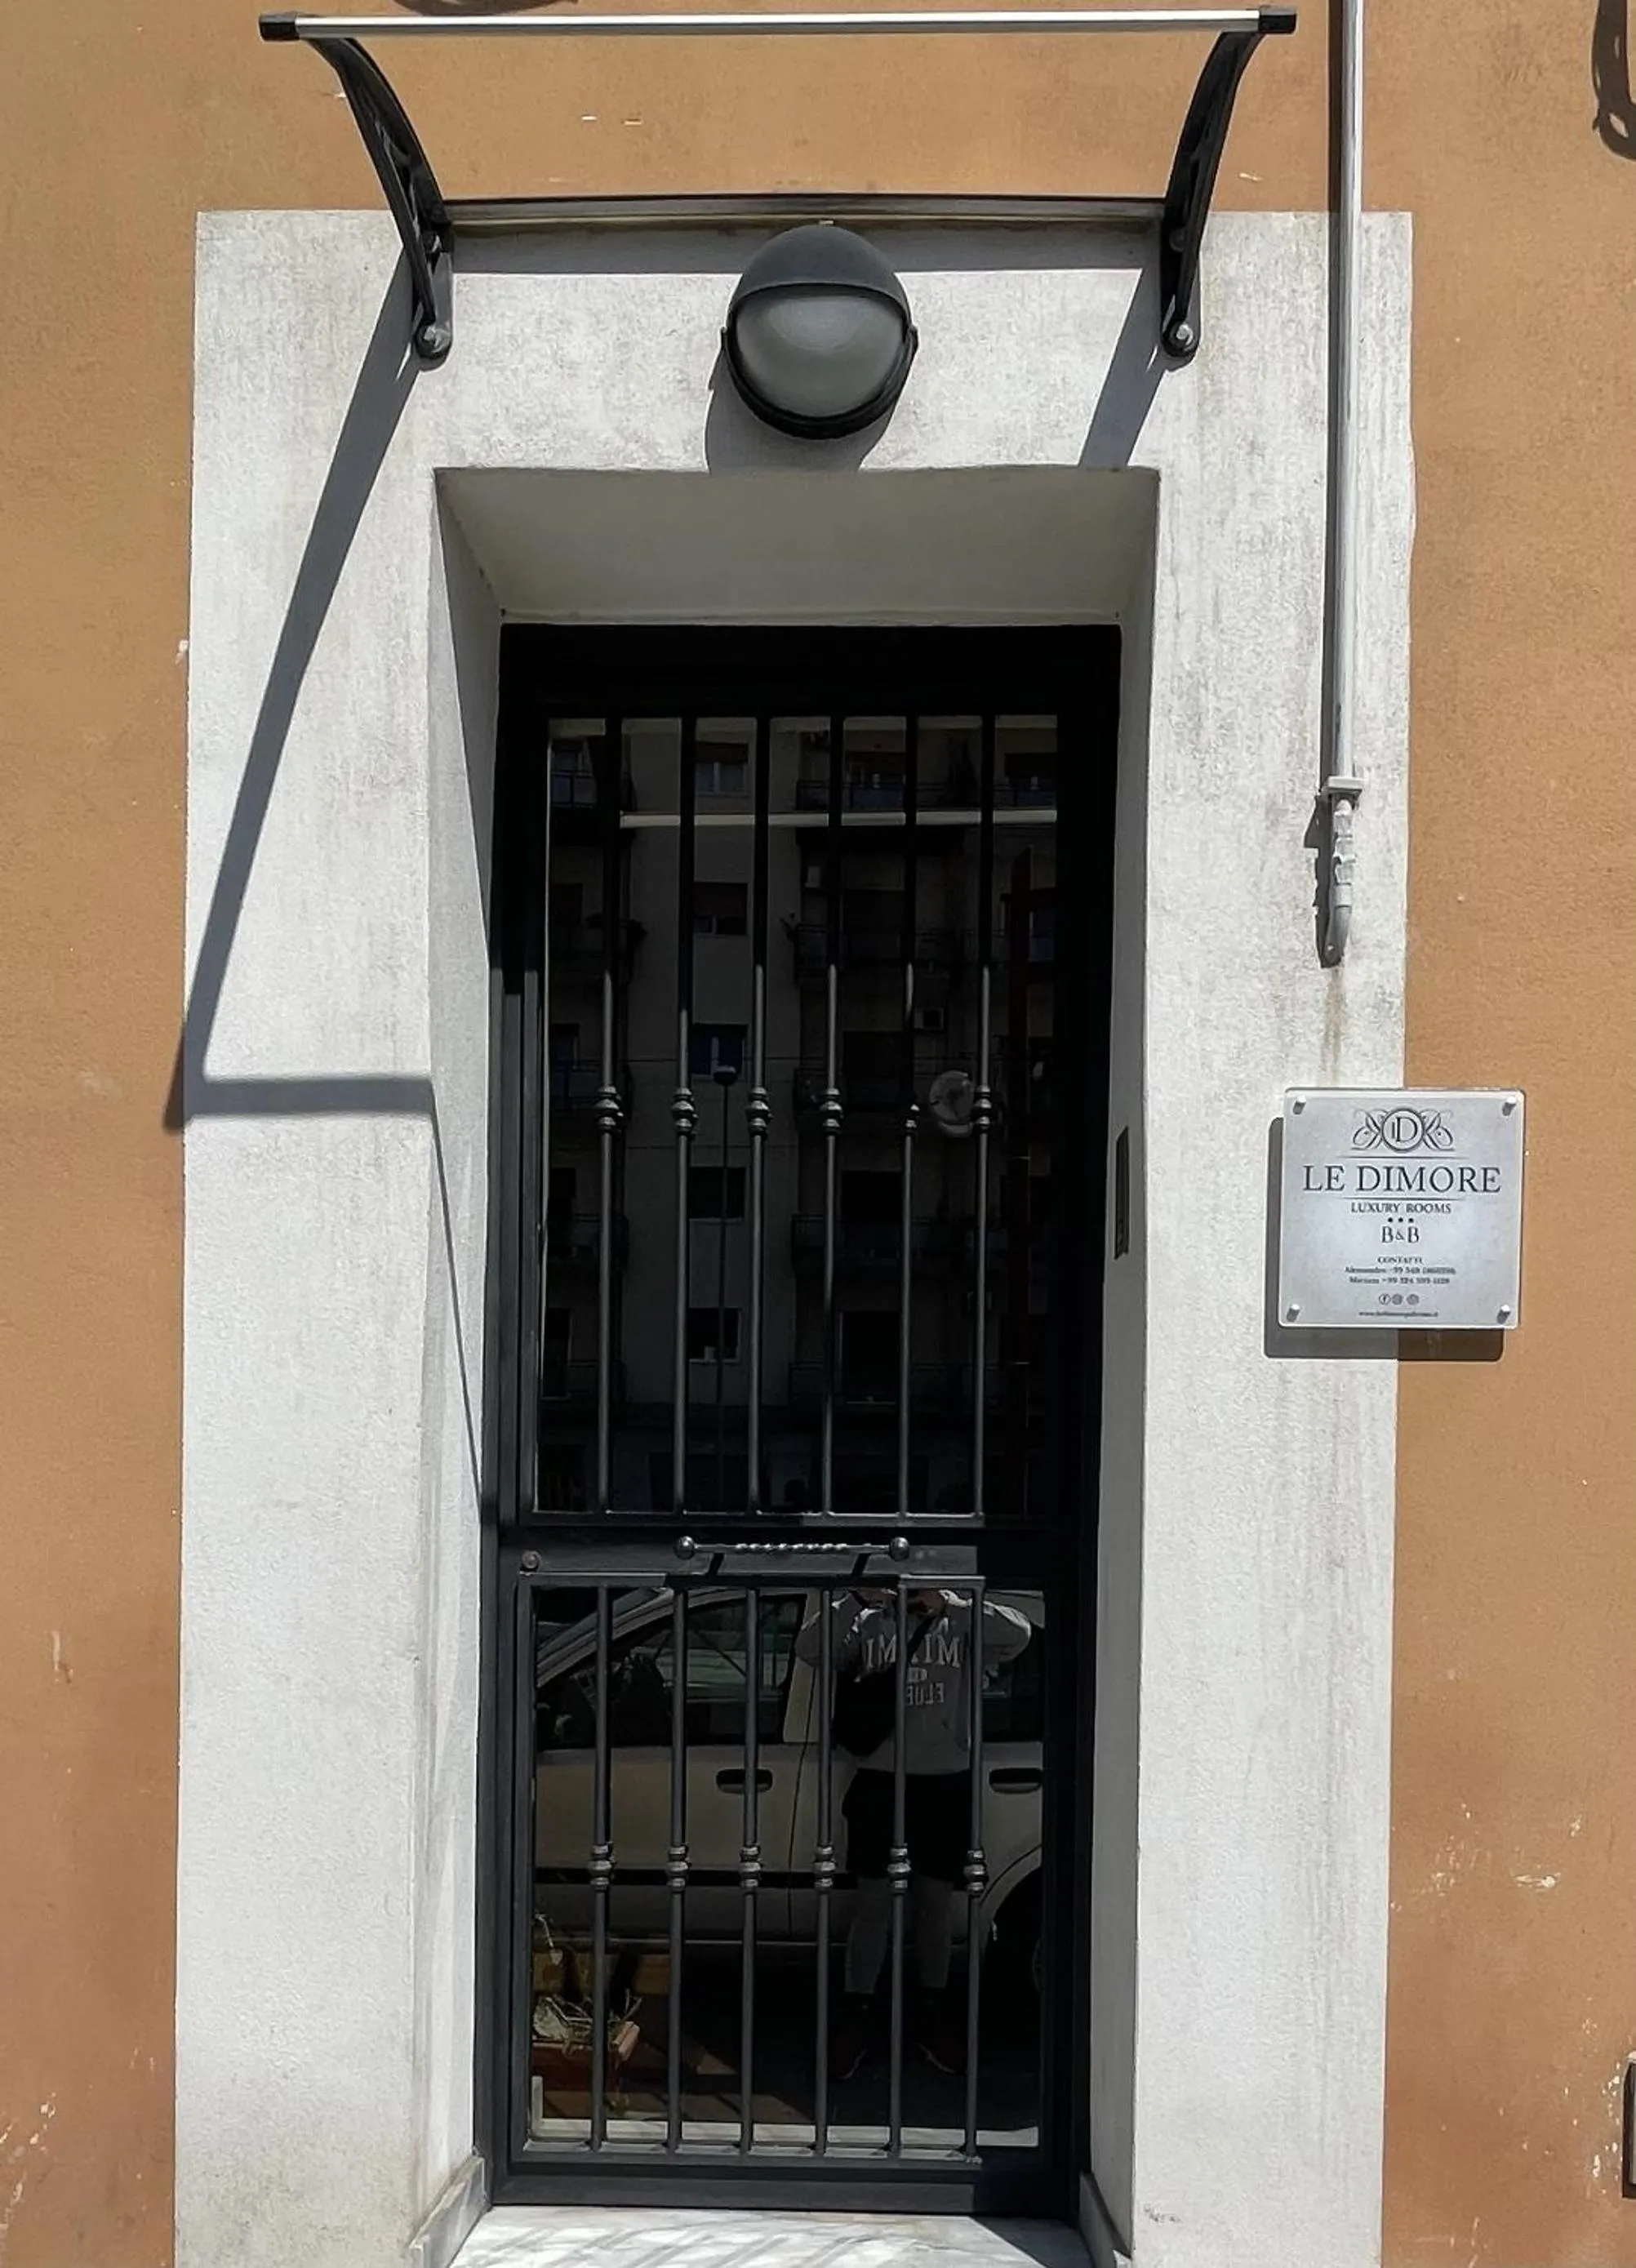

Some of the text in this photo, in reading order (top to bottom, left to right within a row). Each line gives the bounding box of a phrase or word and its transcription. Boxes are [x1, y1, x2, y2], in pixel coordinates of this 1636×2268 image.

[1303, 1165, 1501, 1194] LE DIMORE
[1351, 1202, 1452, 1214] LUXURY ROOMS
[1381, 1225, 1420, 1243] B&B
